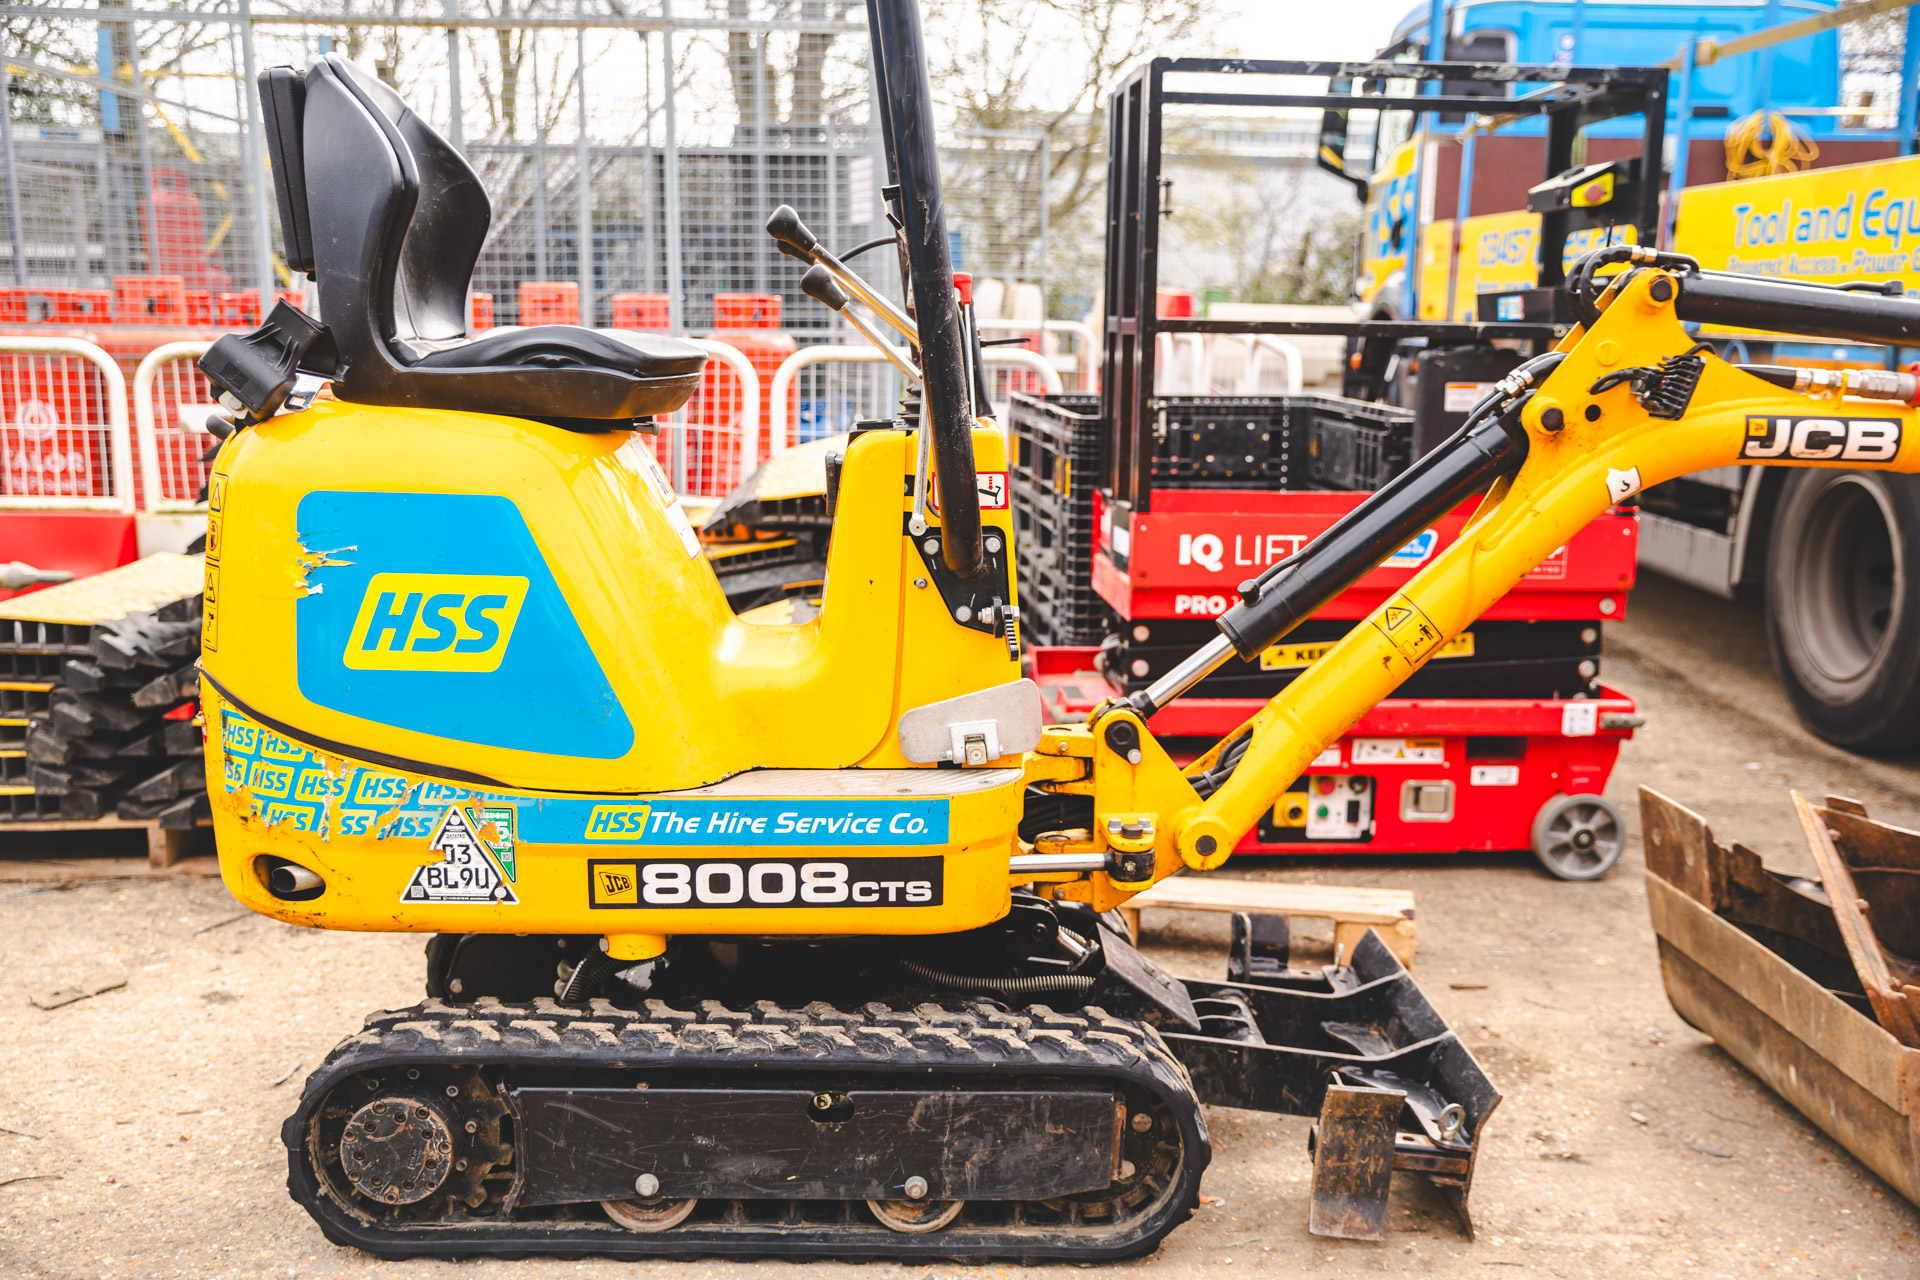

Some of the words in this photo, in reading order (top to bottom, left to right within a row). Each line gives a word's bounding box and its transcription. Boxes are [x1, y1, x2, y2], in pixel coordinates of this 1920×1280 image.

[1735, 201, 1791, 247] Tool
[1796, 193, 1853, 241] and
[1744, 418, 1900, 461] JCB
[1178, 533, 1224, 572] IQ
[1234, 534, 1309, 566] LIFT
[1174, 594, 1228, 615] PRO
[361, 591, 509, 654] HSS
[226, 722, 255, 748] HSS
[300, 774, 347, 797] HSS
[360, 777, 408, 799] HSS
[593, 811, 642, 833] HSS
[650, 811, 701, 834] The
[706, 811, 766, 834] Hire
[773, 811, 882, 834] Service
[889, 811, 929, 834] Co.
[605, 874, 631, 893] JCB
